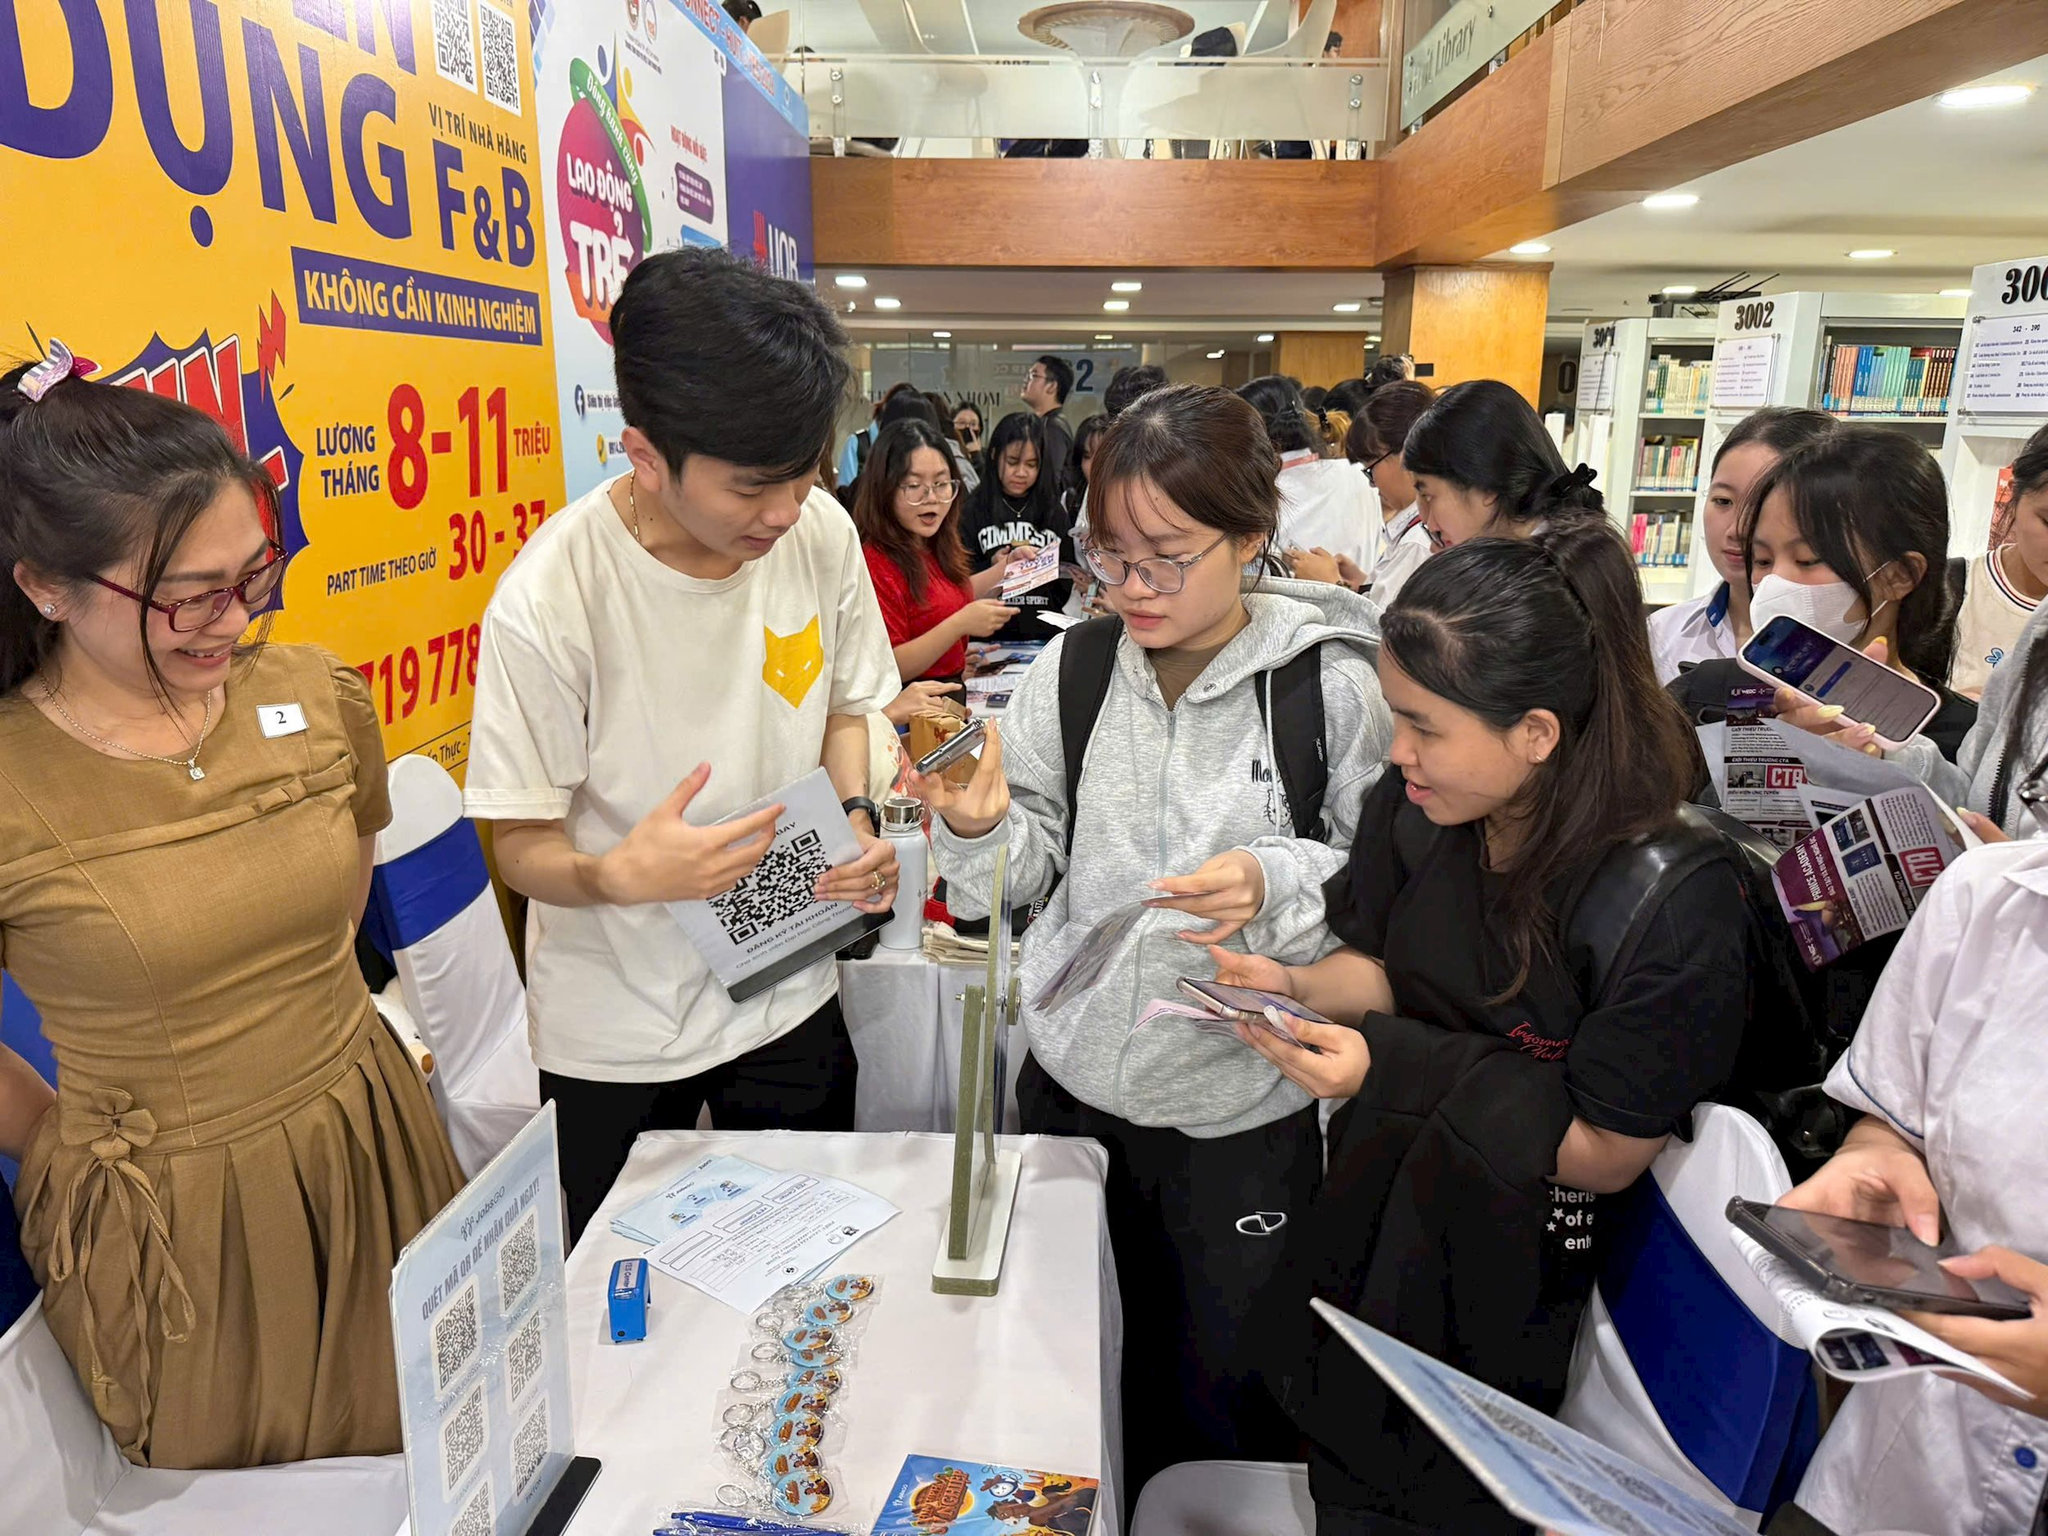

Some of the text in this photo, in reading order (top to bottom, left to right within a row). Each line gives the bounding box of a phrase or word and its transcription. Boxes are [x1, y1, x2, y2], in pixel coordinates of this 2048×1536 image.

[1435, 14, 1477, 76] Library
[428, 102, 527, 164] VỊ TRÍ NHÀ HÀNG
[566, 152, 597, 195] LAO
[596, 160, 633, 213] ĐỘNG
[432, 138, 536, 268] F&B
[303, 267, 537, 341] KHÔNG CẦN KINH NGHIỆM
[1734, 301, 1775, 331] 3002
[315, 423, 376, 457] LƯƠNG
[387, 383, 552, 510] 8-11 TRIỆU
[320, 461, 380, 498] THÁNG
[448, 510, 487, 581] 30
[327, 546, 437, 596] PART TIME THEO GIỜ
[274, 709, 287, 725] 2
[1771, 767, 1804, 787] CTA
[775, 821, 797, 837] GAY
[1795, 843, 1814, 876] ACADEMY
[1904, 850, 1941, 883] CTA
[1805, 874, 1823, 901] PRINCE
[1565, 1209, 1594, 1226] of e
[422, 1283, 443, 1320] QUÉT
[444, 1264, 459, 1296] MÃ
[460, 1254, 472, 1278] QR
[483, 1217, 504, 1251] NHẬN
[504, 1198, 519, 1227] QUÀ
[520, 1177, 540, 1210] NGAY!
